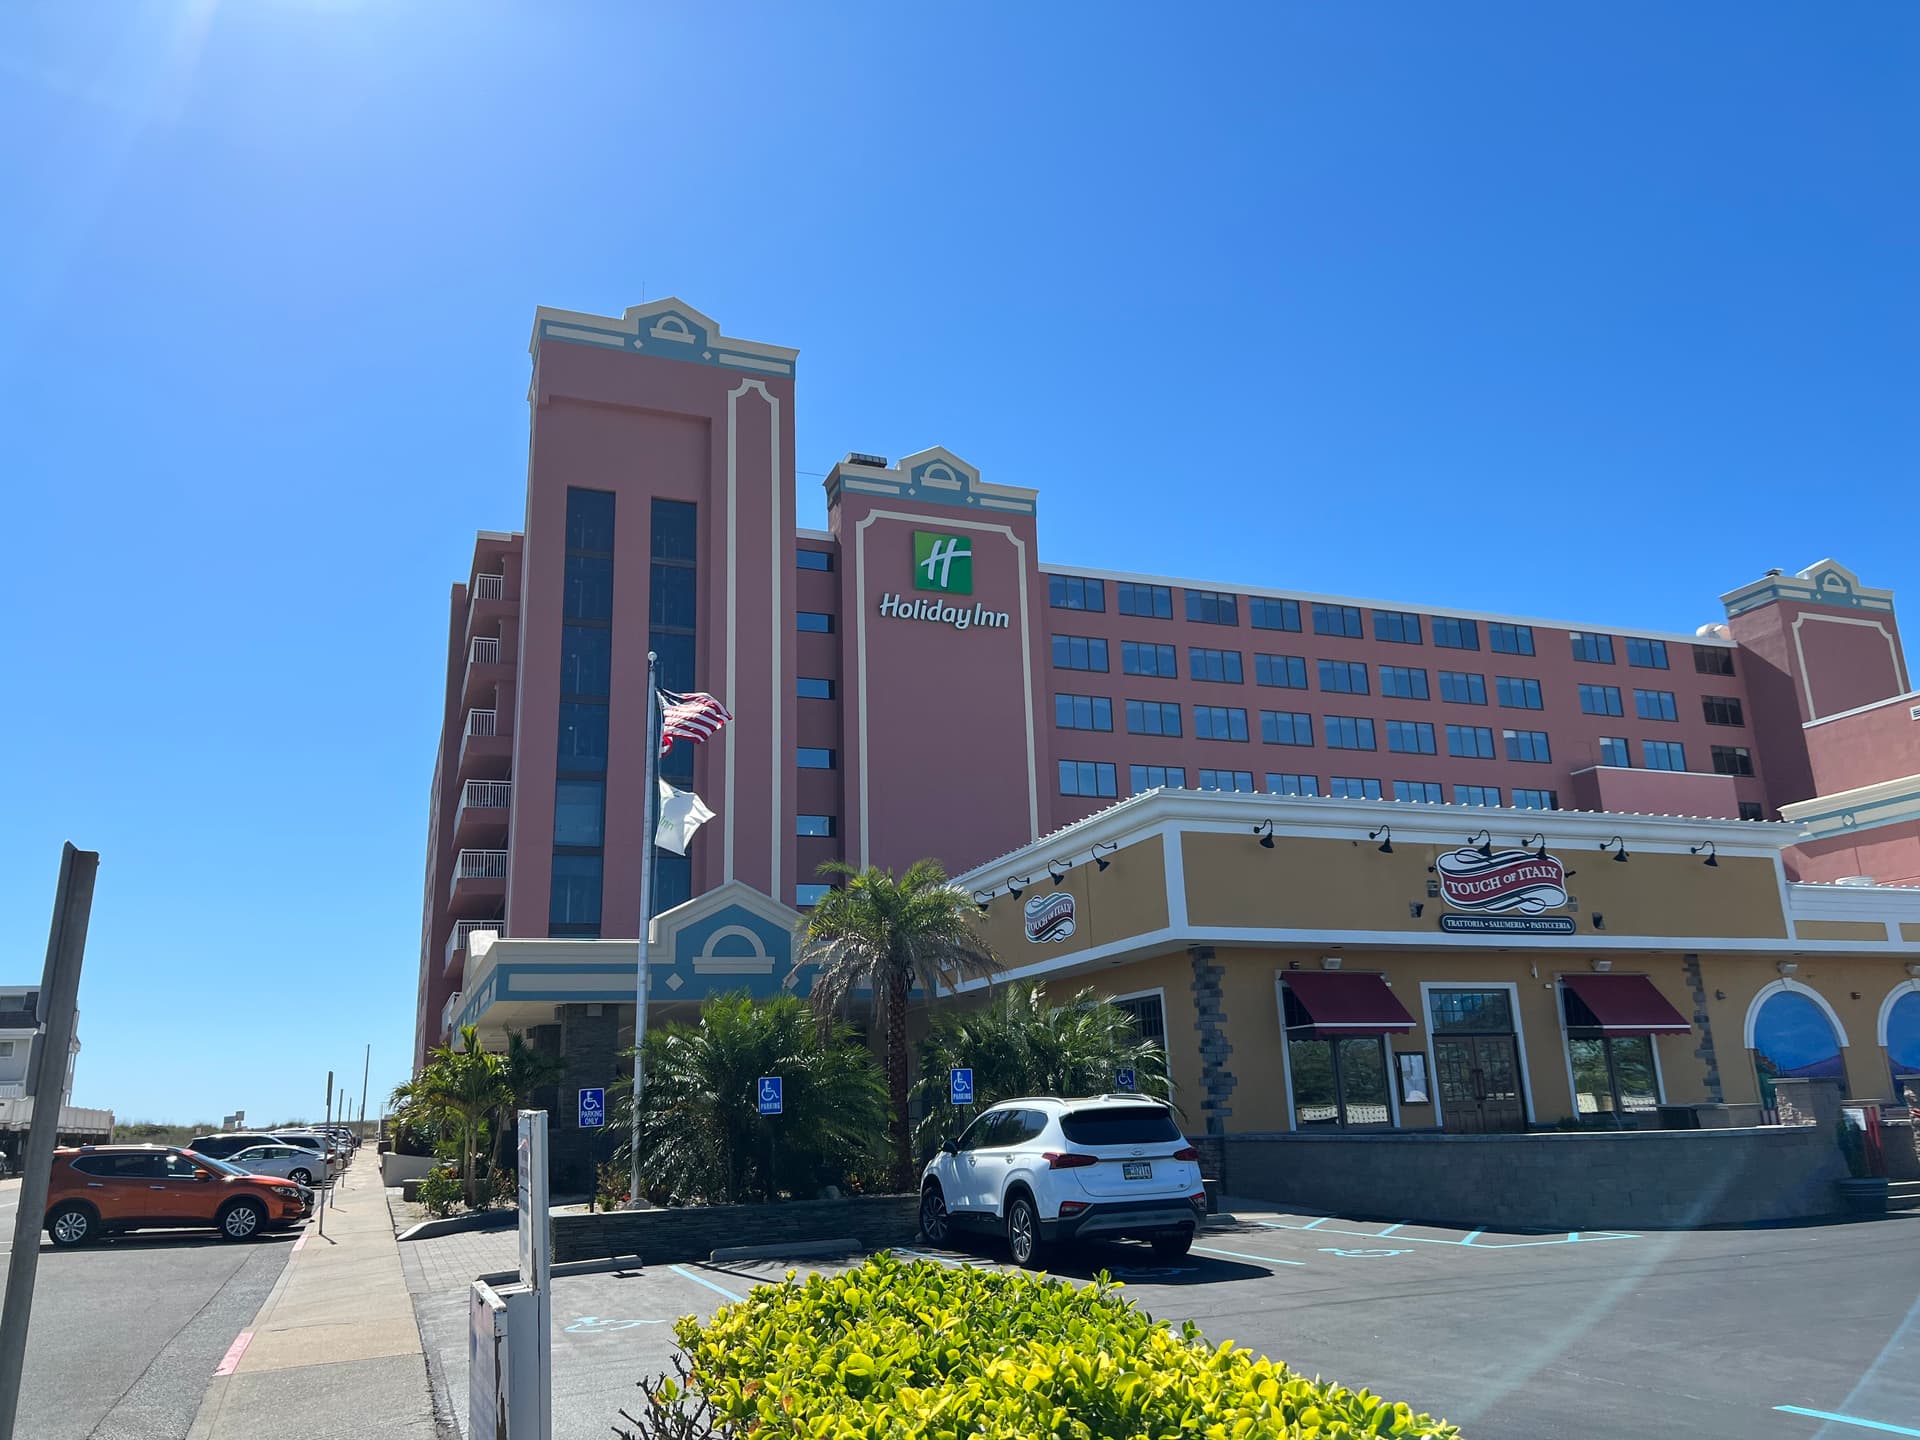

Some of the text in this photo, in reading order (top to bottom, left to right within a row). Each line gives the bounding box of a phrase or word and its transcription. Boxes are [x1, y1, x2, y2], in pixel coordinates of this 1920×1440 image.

[880, 592, 1010, 630] Holiday Inn
[1446, 865, 1558, 895] TOUCH OF ITALY
[1446, 919, 1571, 930] TRATTORIA SALUMERIA PASTICCERIA
[581, 1110, 603, 1118] PARKING
[584, 1117, 599, 1125] ONLY
